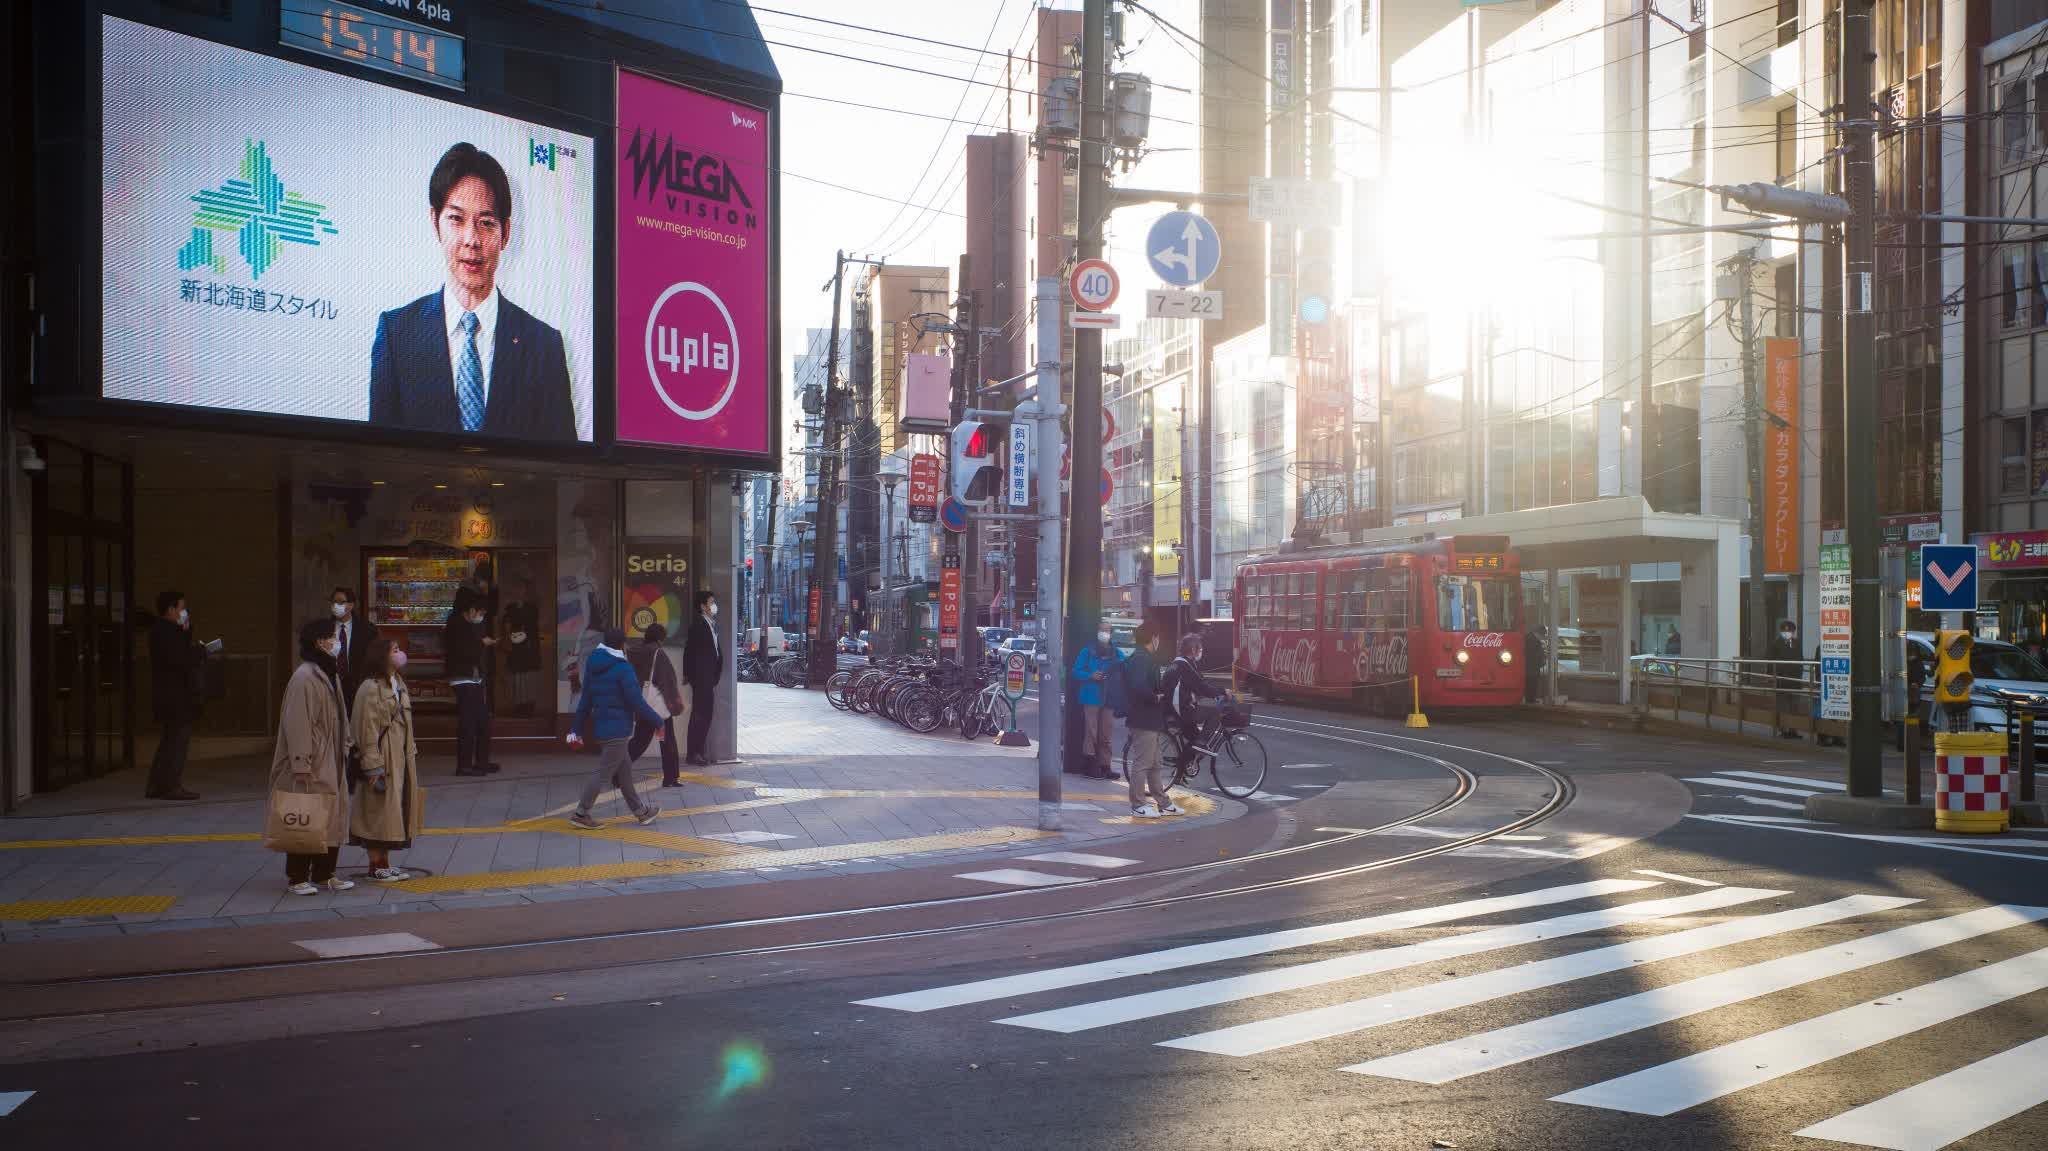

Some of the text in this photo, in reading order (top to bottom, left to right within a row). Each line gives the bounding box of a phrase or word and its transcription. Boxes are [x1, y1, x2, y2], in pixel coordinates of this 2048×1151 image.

[416, 0, 451, 22] 4pla
[321, 9, 436, 75] 15:14
[624, 124, 752, 208] MEGA
[636, 214, 747, 249] www.mega-vision.co.jp
[666, 194, 757, 229] VISION
[179, 278, 339, 320] 新北海道スタイル
[1081, 273, 1109, 297] 40
[658, 325, 729, 374] 4pla
[912, 459, 927, 502] LIPS
[1013, 427, 1026, 503] 斜め横断専用
[628, 553, 687, 573] Seria
[944, 571, 957, 613] LIPS
[283, 812, 310, 826] GU
